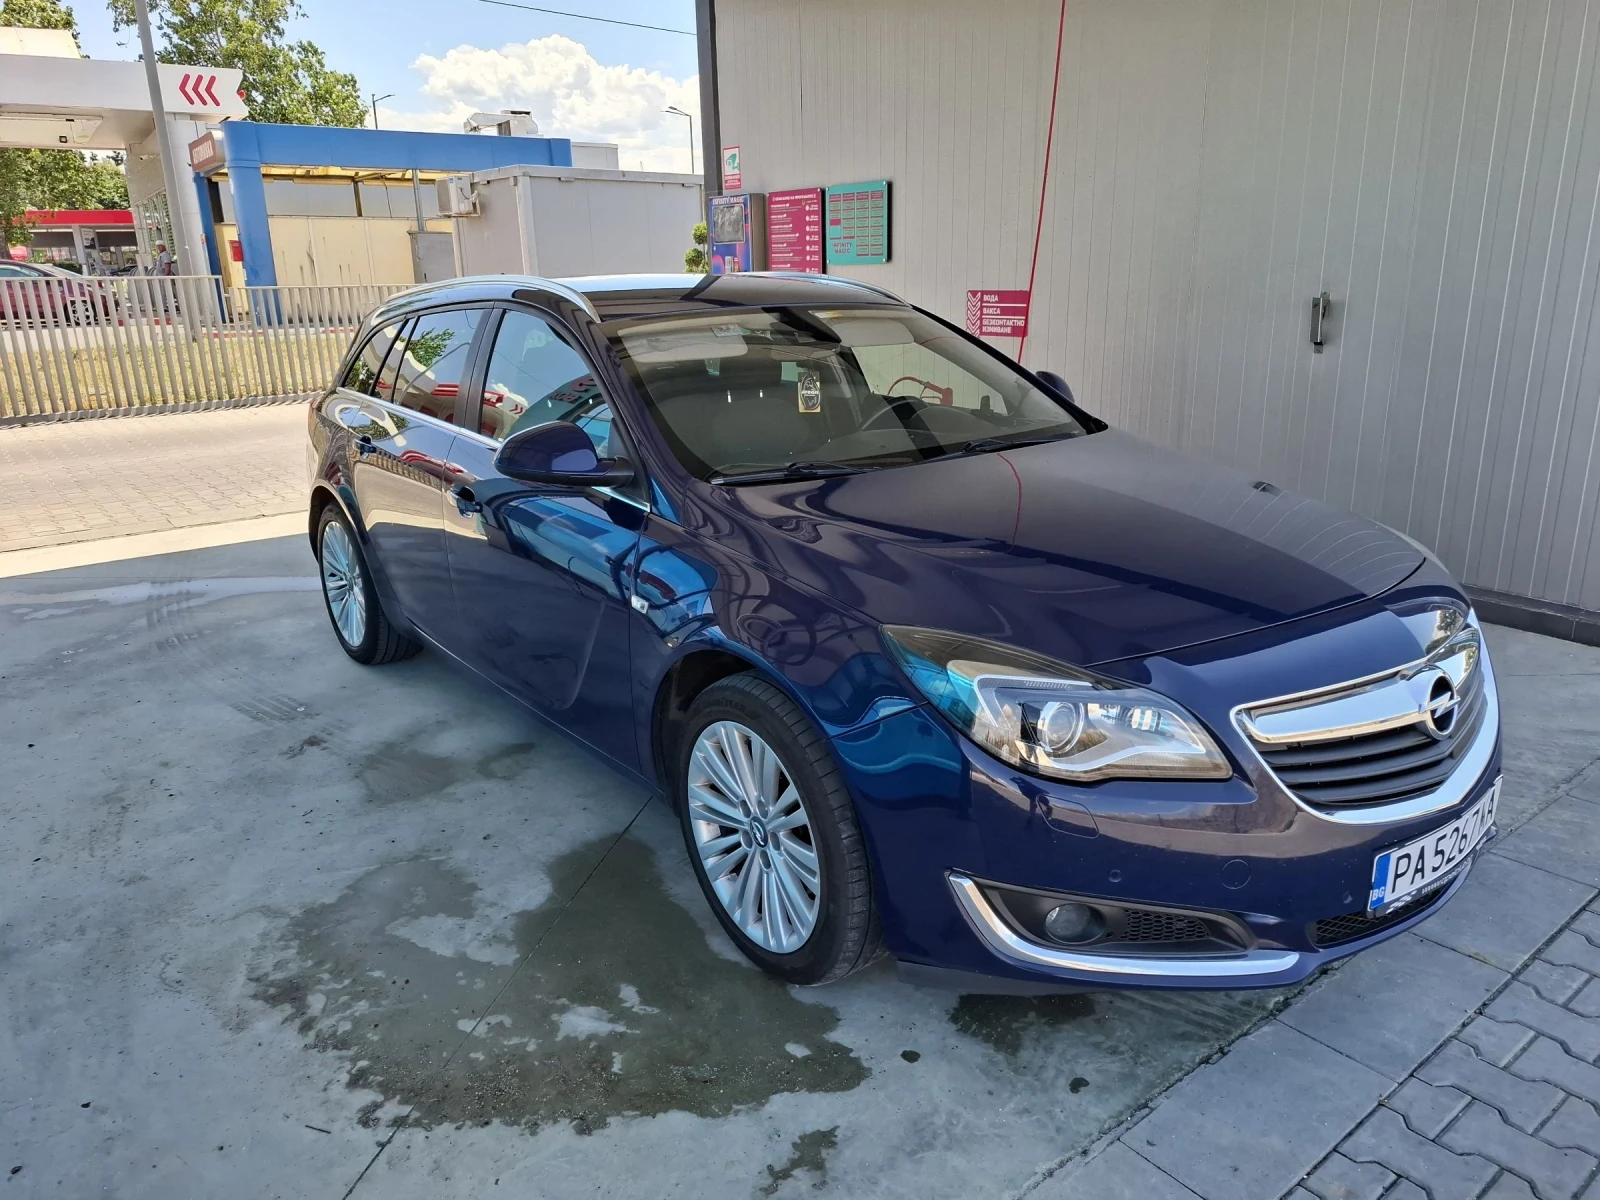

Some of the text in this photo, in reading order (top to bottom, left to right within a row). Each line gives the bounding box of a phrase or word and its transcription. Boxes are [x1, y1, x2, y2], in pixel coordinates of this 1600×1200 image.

[982, 319, 1025, 327] БЕЗКОНТАКТНО
[1391, 845, 1425, 893] PA
[1431, 808, 1479, 873] 5267
[1371, 886, 1385, 901] BG
